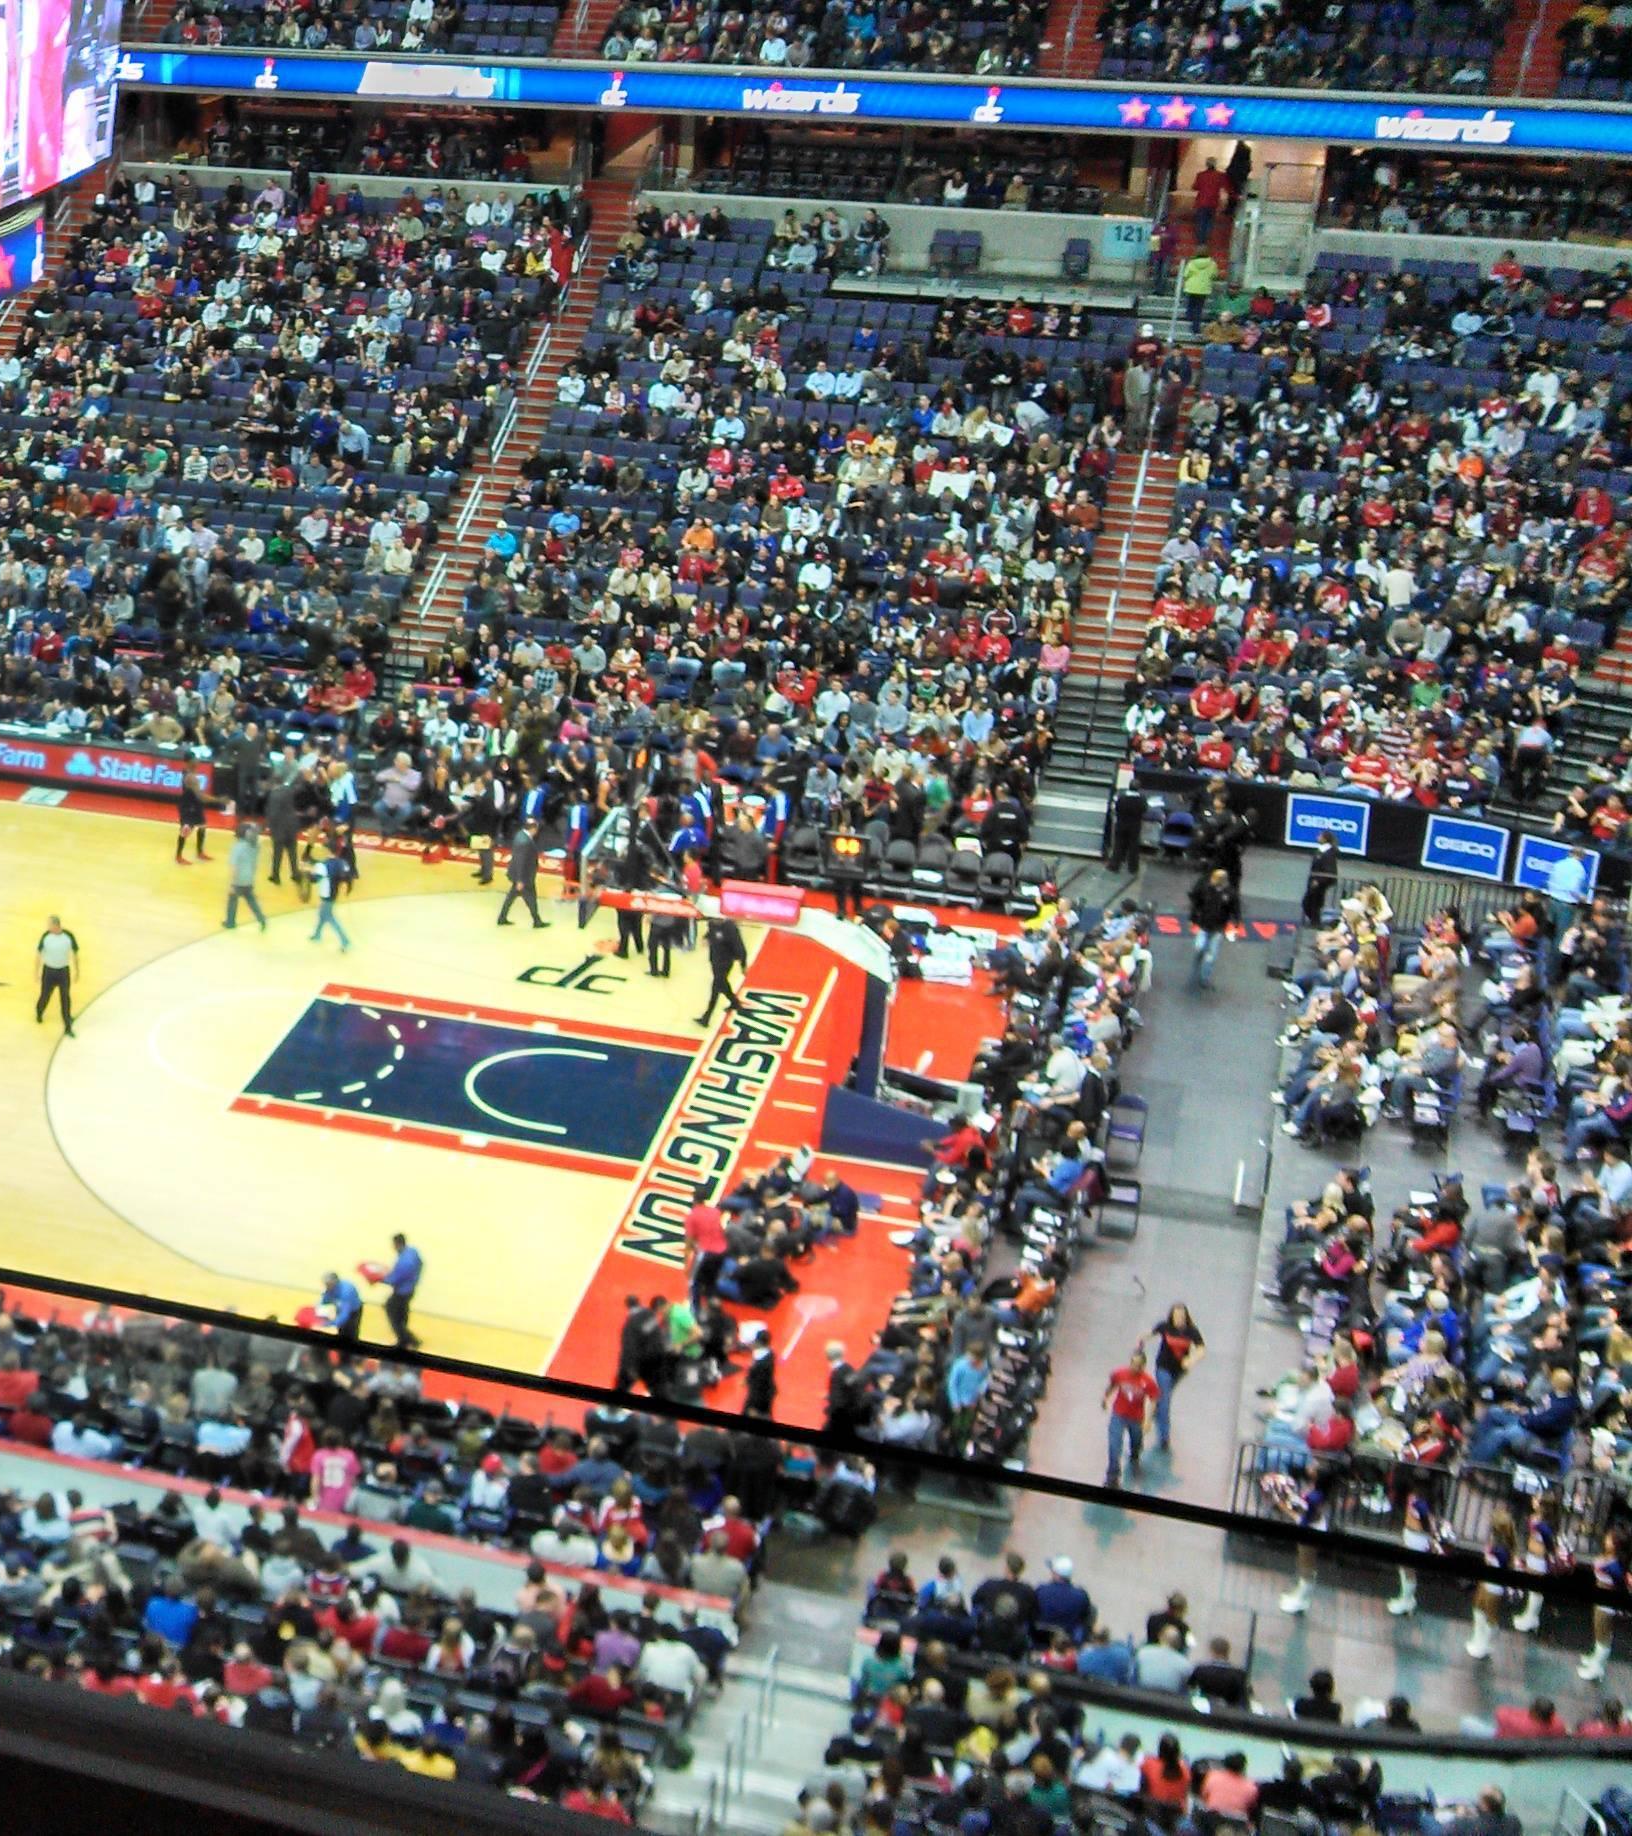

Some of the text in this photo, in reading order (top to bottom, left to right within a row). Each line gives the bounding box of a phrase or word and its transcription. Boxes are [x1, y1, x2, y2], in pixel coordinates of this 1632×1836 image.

[743, 82, 861, 113] wizards
[1375, 110, 1515, 145] wizards
[1115, 224, 1143, 242] 121
[1296, 813, 1358, 834] GEICO
[1434, 835, 1497, 858] GEICO
[621, 991, 804, 1264] WASHINGTON
